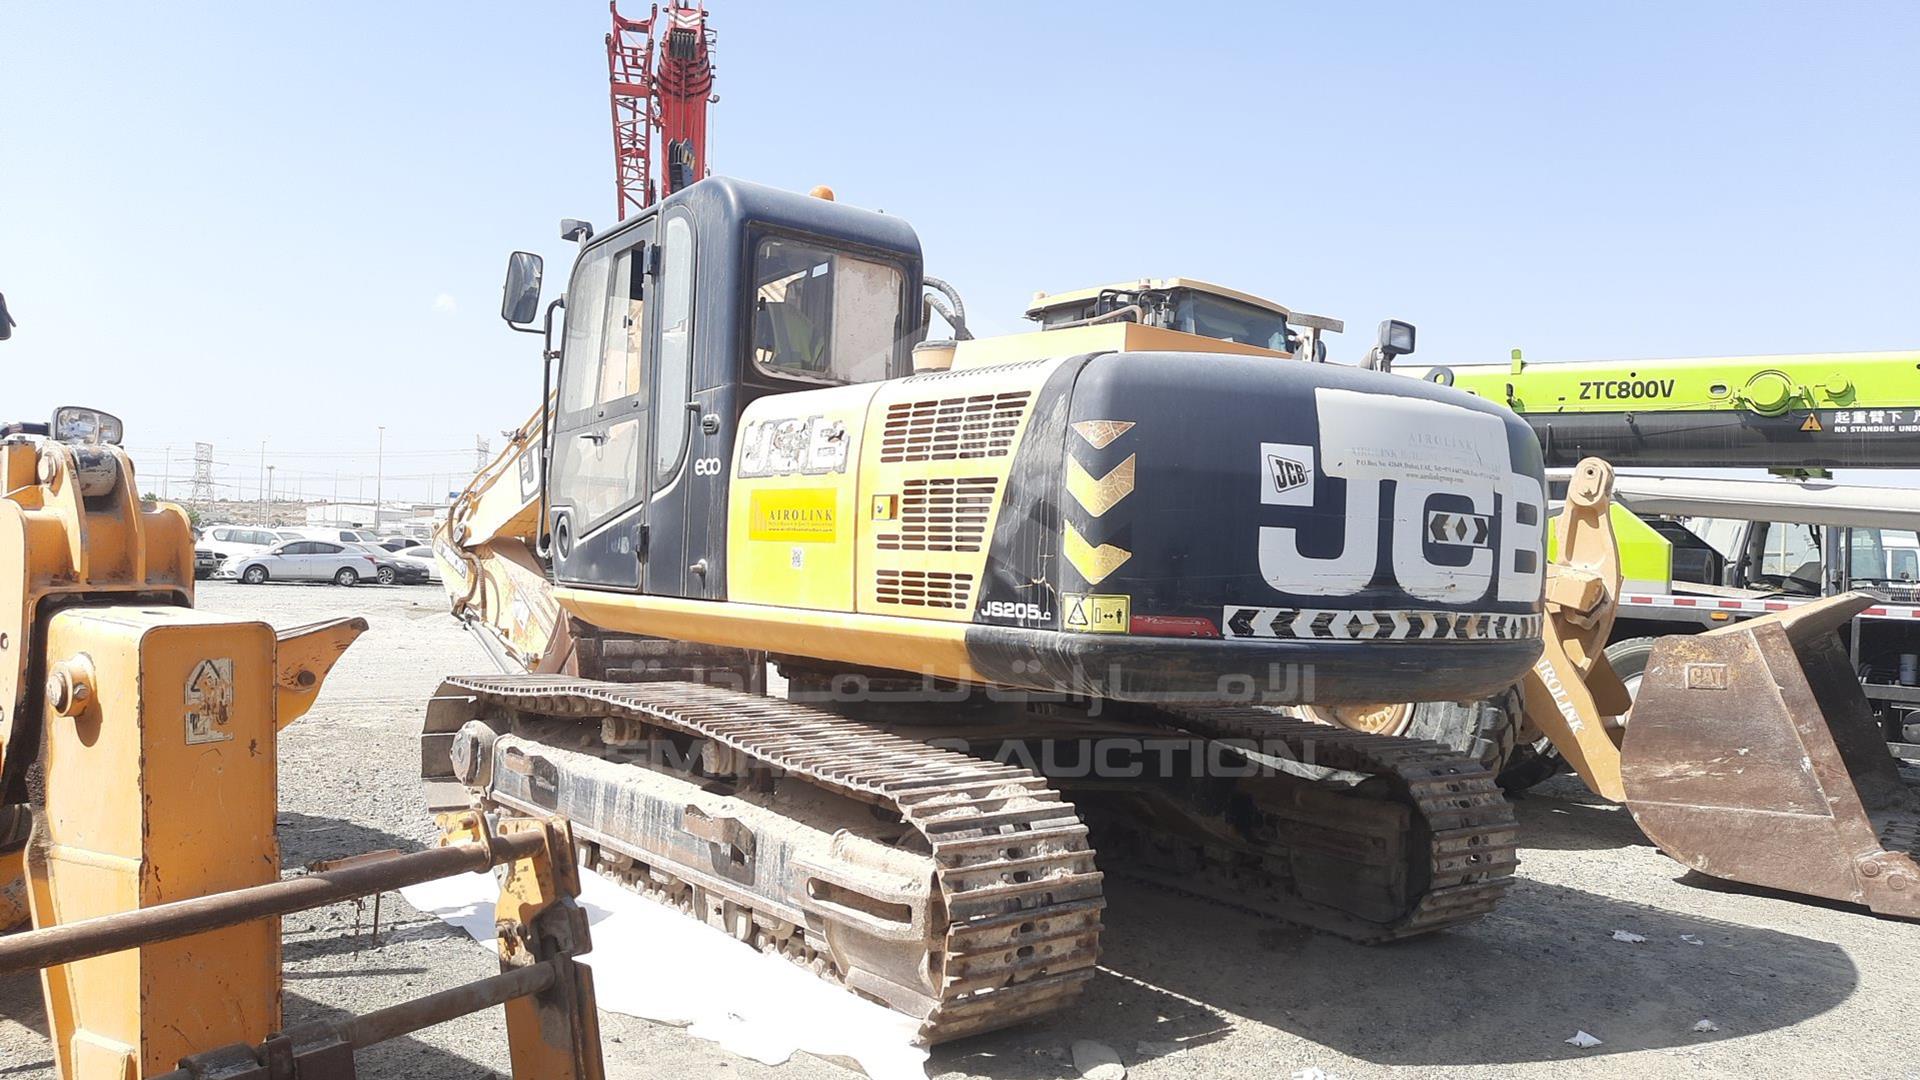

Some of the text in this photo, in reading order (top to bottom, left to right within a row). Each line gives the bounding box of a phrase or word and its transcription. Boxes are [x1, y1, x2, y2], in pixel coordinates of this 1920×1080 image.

[1579, 379, 1675, 400] ZTC800V
[1834, 410, 1904, 424] 起重臂下
[1899, 425, 1920, 433] UND
[695, 457, 721, 476] eco
[1275, 459, 1306, 489] JCB
[769, 509, 832, 521] AIROLINK
[1258, 450, 1545, 605] JCB
[1690, 667, 1724, 687] CAT
